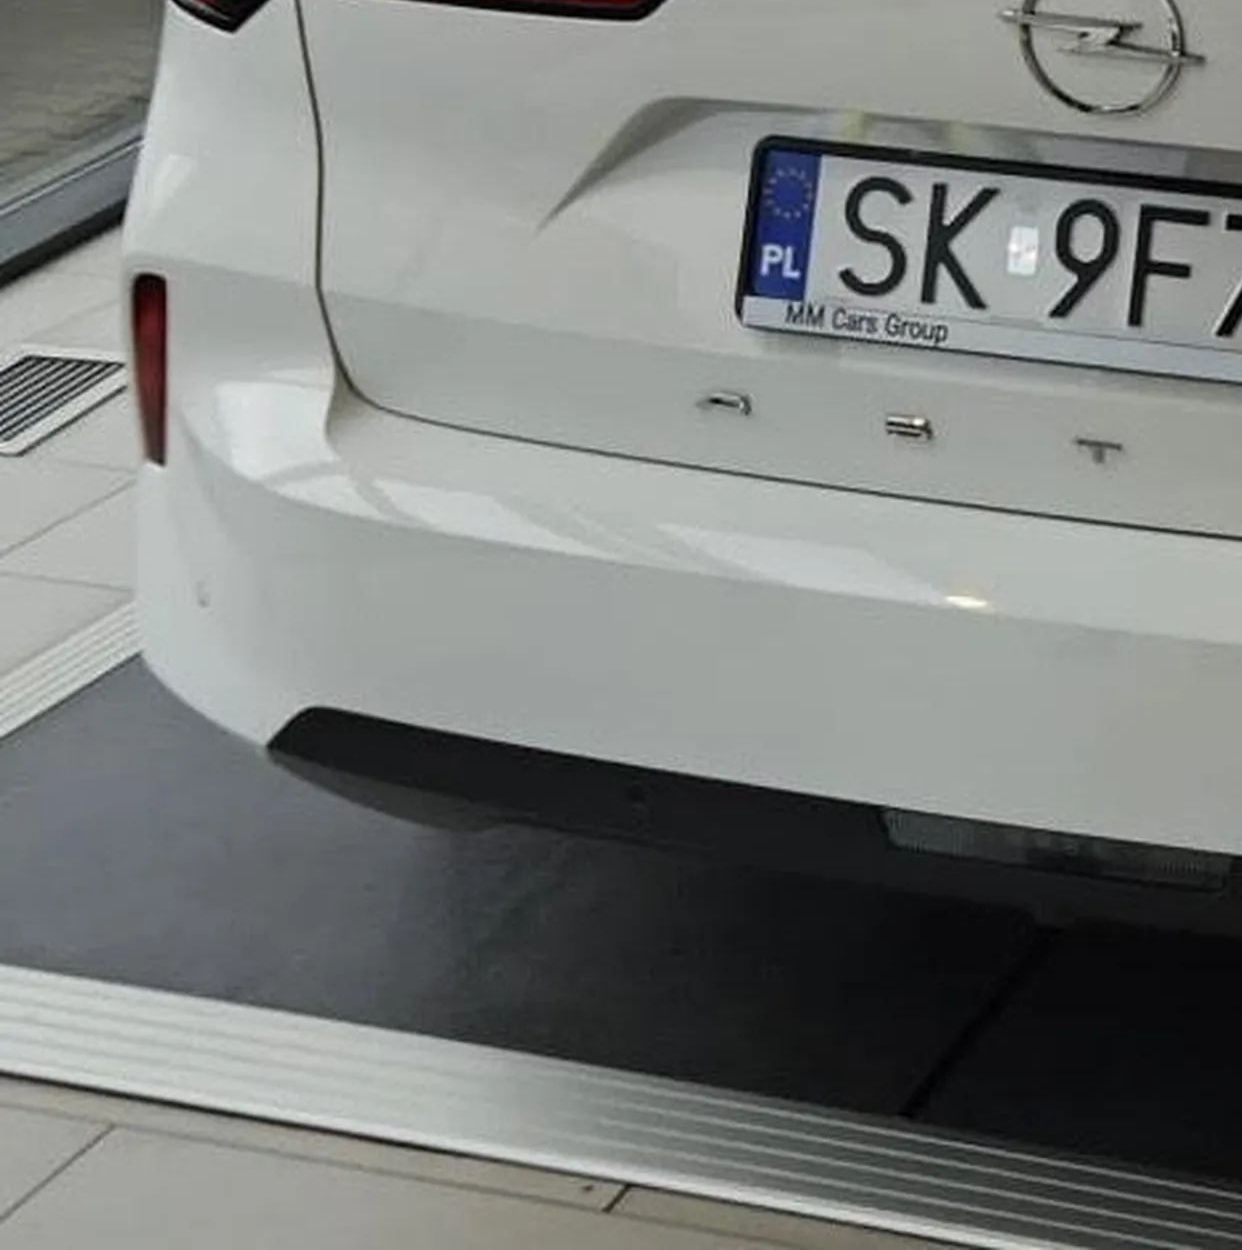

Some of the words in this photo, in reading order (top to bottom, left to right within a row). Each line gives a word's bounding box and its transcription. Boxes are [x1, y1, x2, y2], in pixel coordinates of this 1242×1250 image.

[760, 244, 801, 280] PL
[836, 175, 1001, 311] SK
[784, 302, 826, 329] MM
[831, 307, 880, 334] Cars
[884, 313, 949, 345] Group
